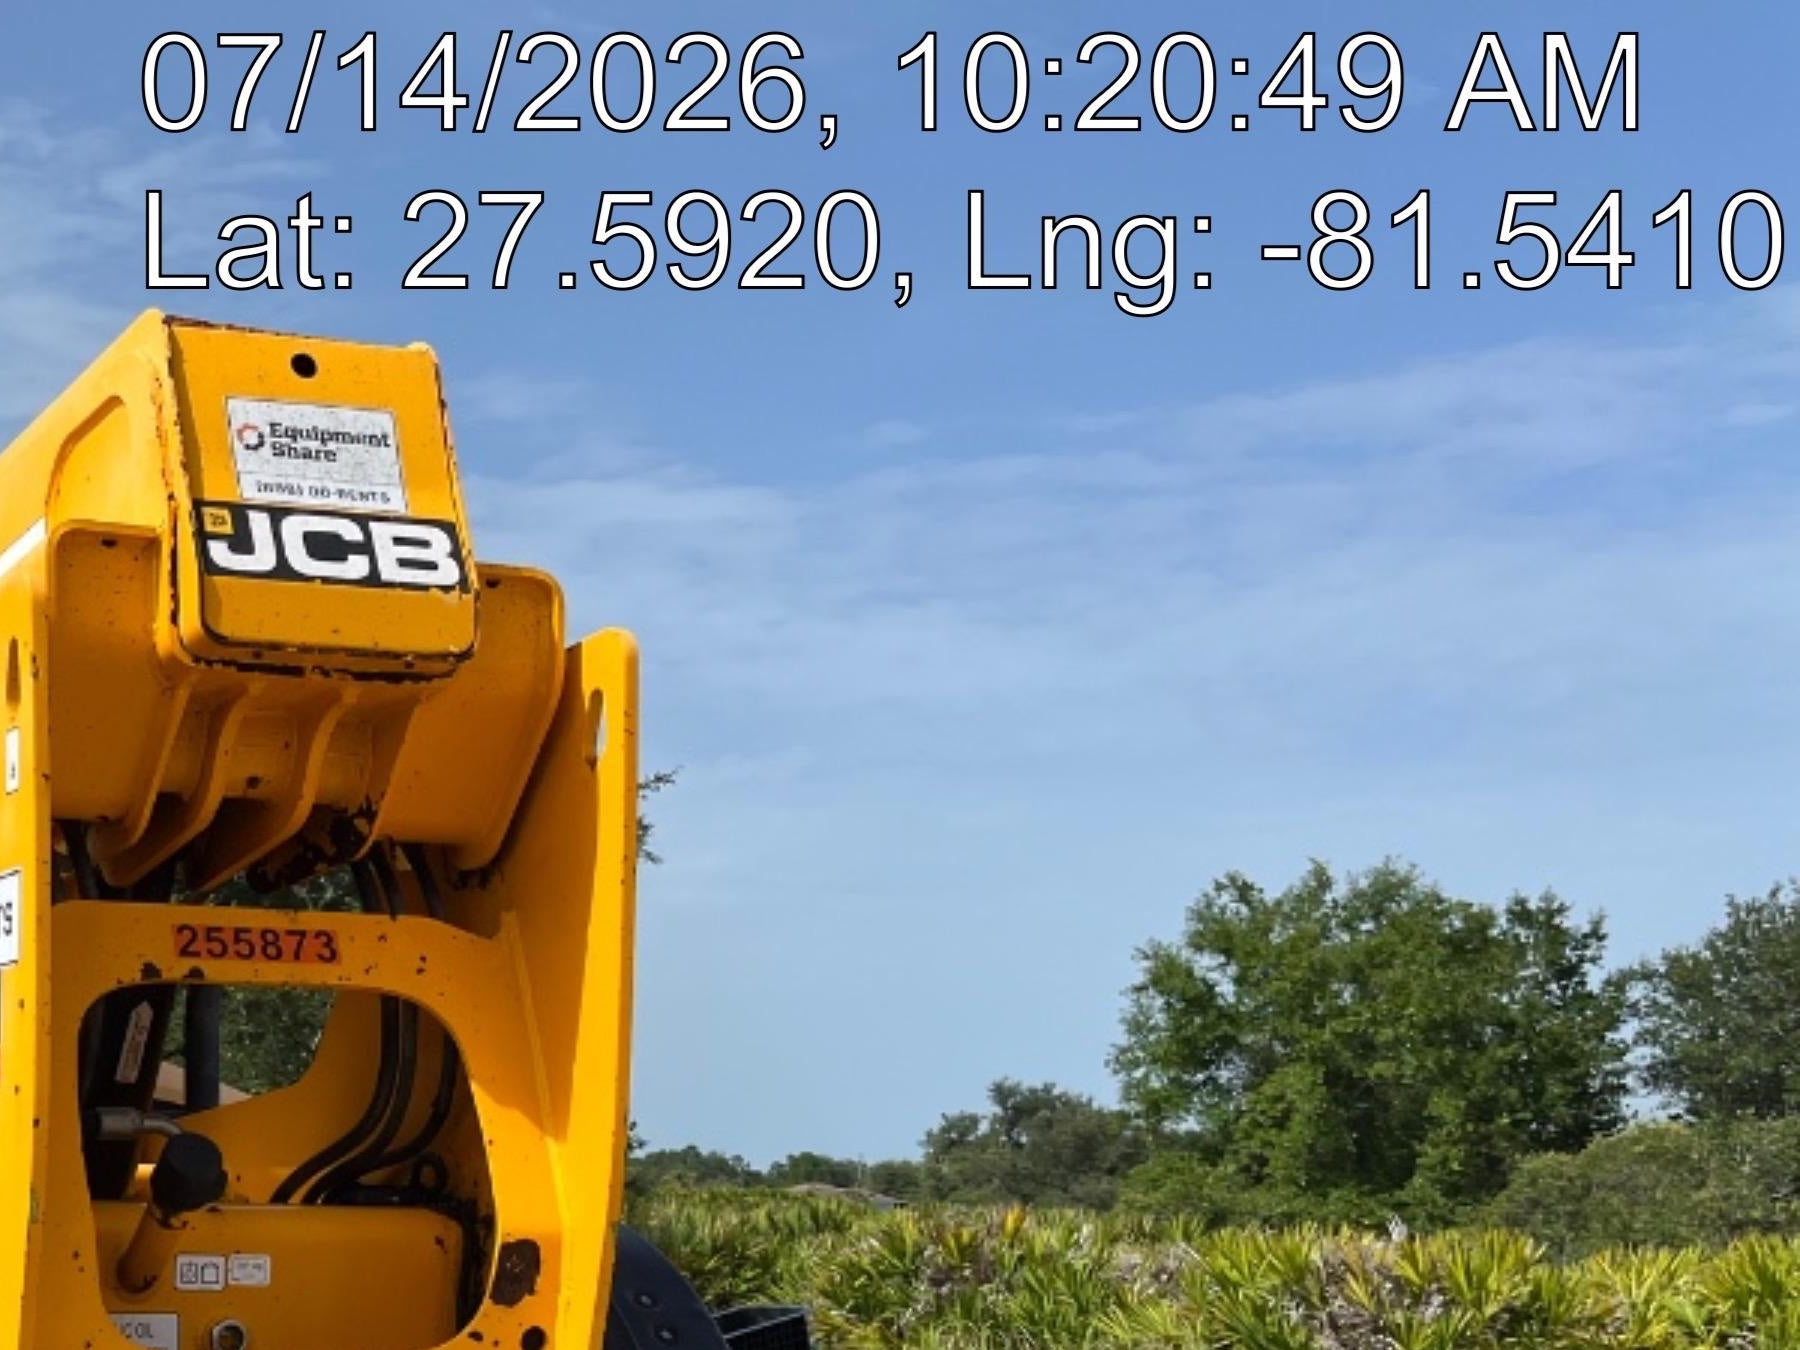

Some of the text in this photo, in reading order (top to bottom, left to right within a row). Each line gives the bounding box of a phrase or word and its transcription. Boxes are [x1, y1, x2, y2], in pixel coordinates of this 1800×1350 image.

[271, 442, 337, 462] Share
[206, 510, 460, 586] JCB
[176, 923, 338, 963] 255873
